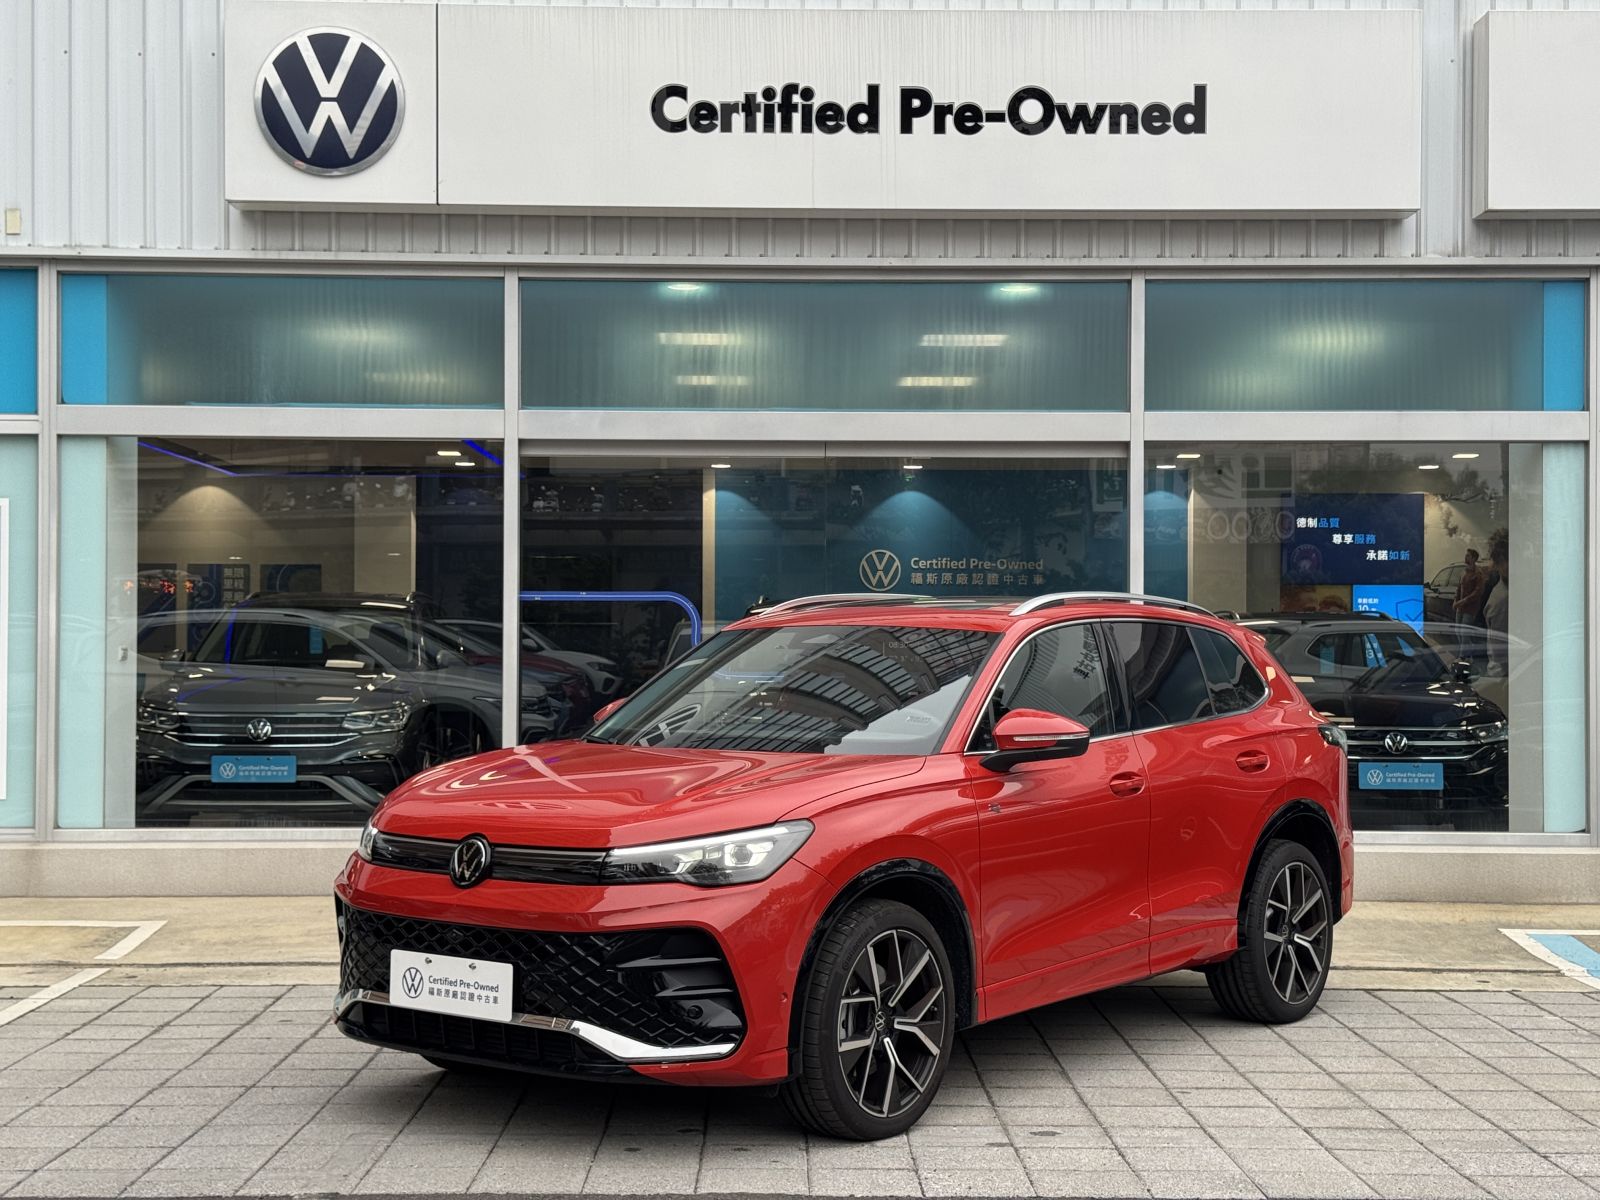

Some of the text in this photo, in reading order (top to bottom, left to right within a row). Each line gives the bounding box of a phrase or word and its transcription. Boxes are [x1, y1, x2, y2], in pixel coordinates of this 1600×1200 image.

[650, 83, 1208, 136] Certified Pre-Owned
[1332, 533, 1377, 545] 尊享服務
[1366, 549, 1410, 561] 承諾如新
[910, 557, 1044, 570] Certified Pre-Owned
[910, 572, 1045, 586] 福斯原廠認證中古車
[428, 975, 499, 992] Certified Pre-Owned
